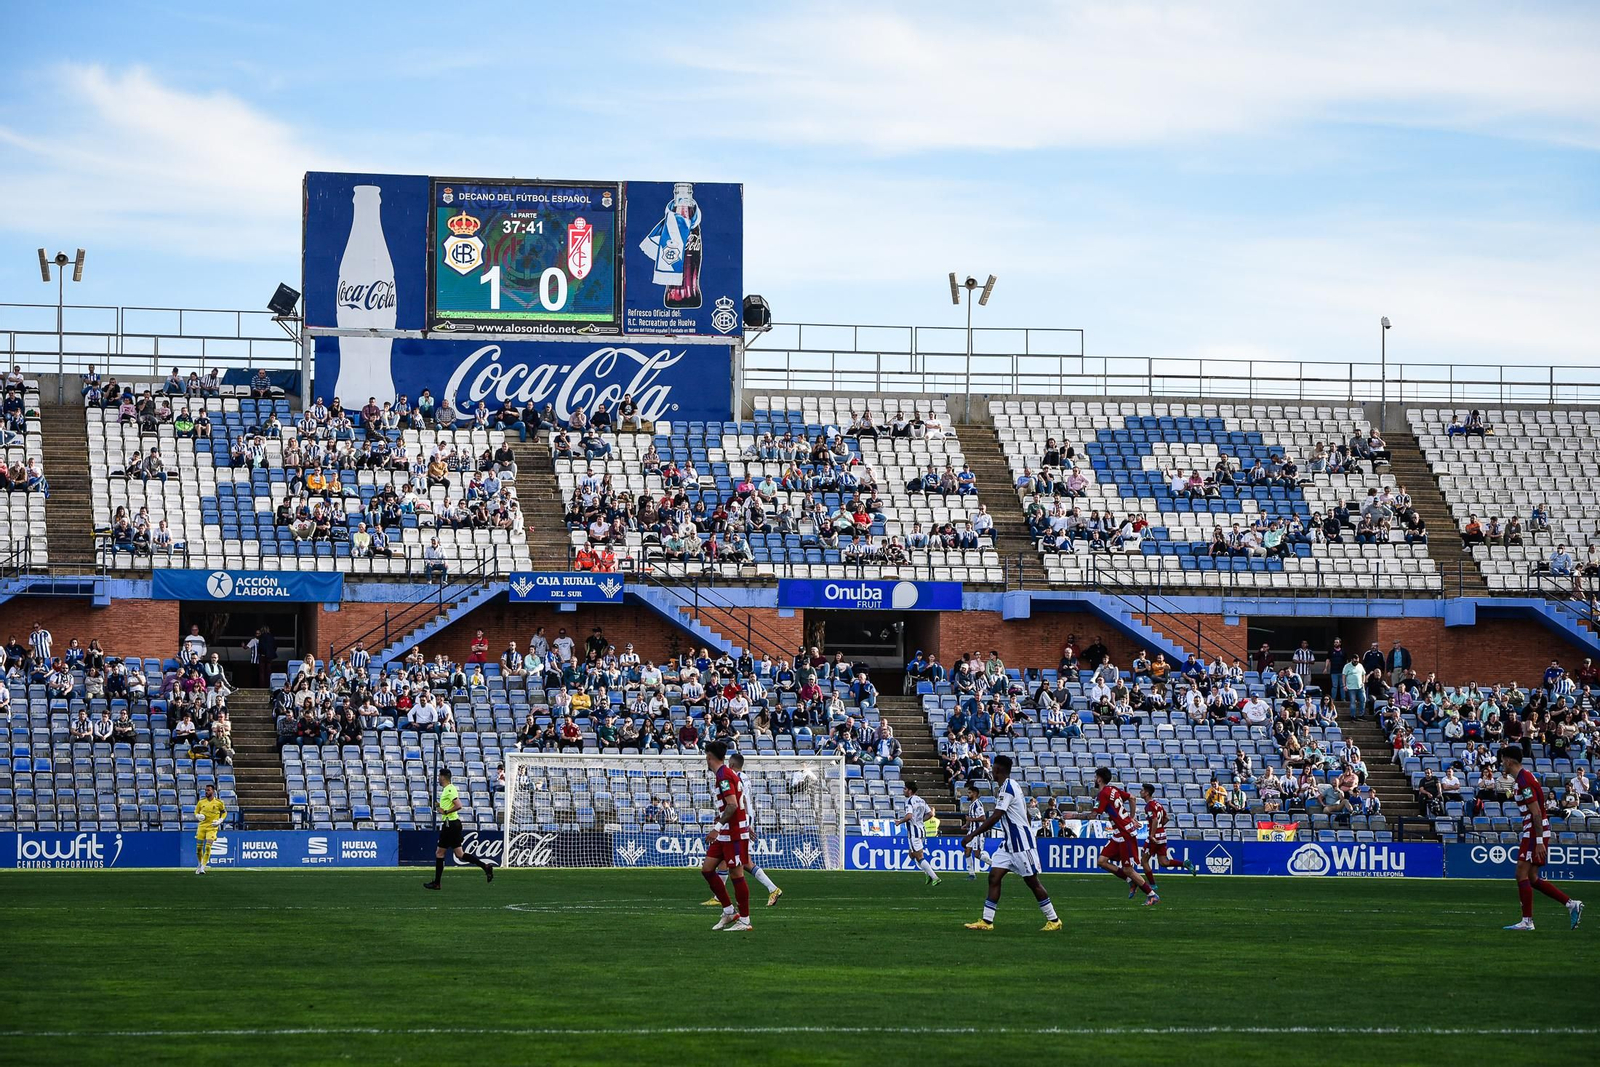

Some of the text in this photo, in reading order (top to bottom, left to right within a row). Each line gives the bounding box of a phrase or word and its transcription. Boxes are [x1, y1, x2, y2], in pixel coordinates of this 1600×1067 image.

[459, 192, 592, 204] DECANO DEL FÚTBOL ESPAÑOL
[502, 220, 544, 234] 37:41
[480, 266, 500, 310] 1
[539, 267, 568, 311] 0
[338, 280, 395, 310] Coca-Cola
[628, 308, 652, 317] Refresco
[653, 309, 670, 317] Oficial
[638, 318, 668, 327] Recreativo
[476, 324, 576, 334] www.alosonido.net
[444, 344, 687, 422] Coca-Cola
[236, 575, 277, 586] ACCIÓN
[536, 577, 596, 586] CAJA RURAL
[235, 587, 290, 596] LABORAL
[824, 584, 882, 600] Onuba
[17, 833, 104, 859] lowfit
[242, 841, 278, 850] HUELVA
[342, 841, 377, 849] HUELVA
[656, 836, 706, 856] CAJA
[242, 851, 277, 859] MOTOR
[342, 850, 377, 859] MOTOR
[1331, 844, 1405, 870] WiHu
[17, 860, 104, 868] CENTROS DEPORTIVOS
